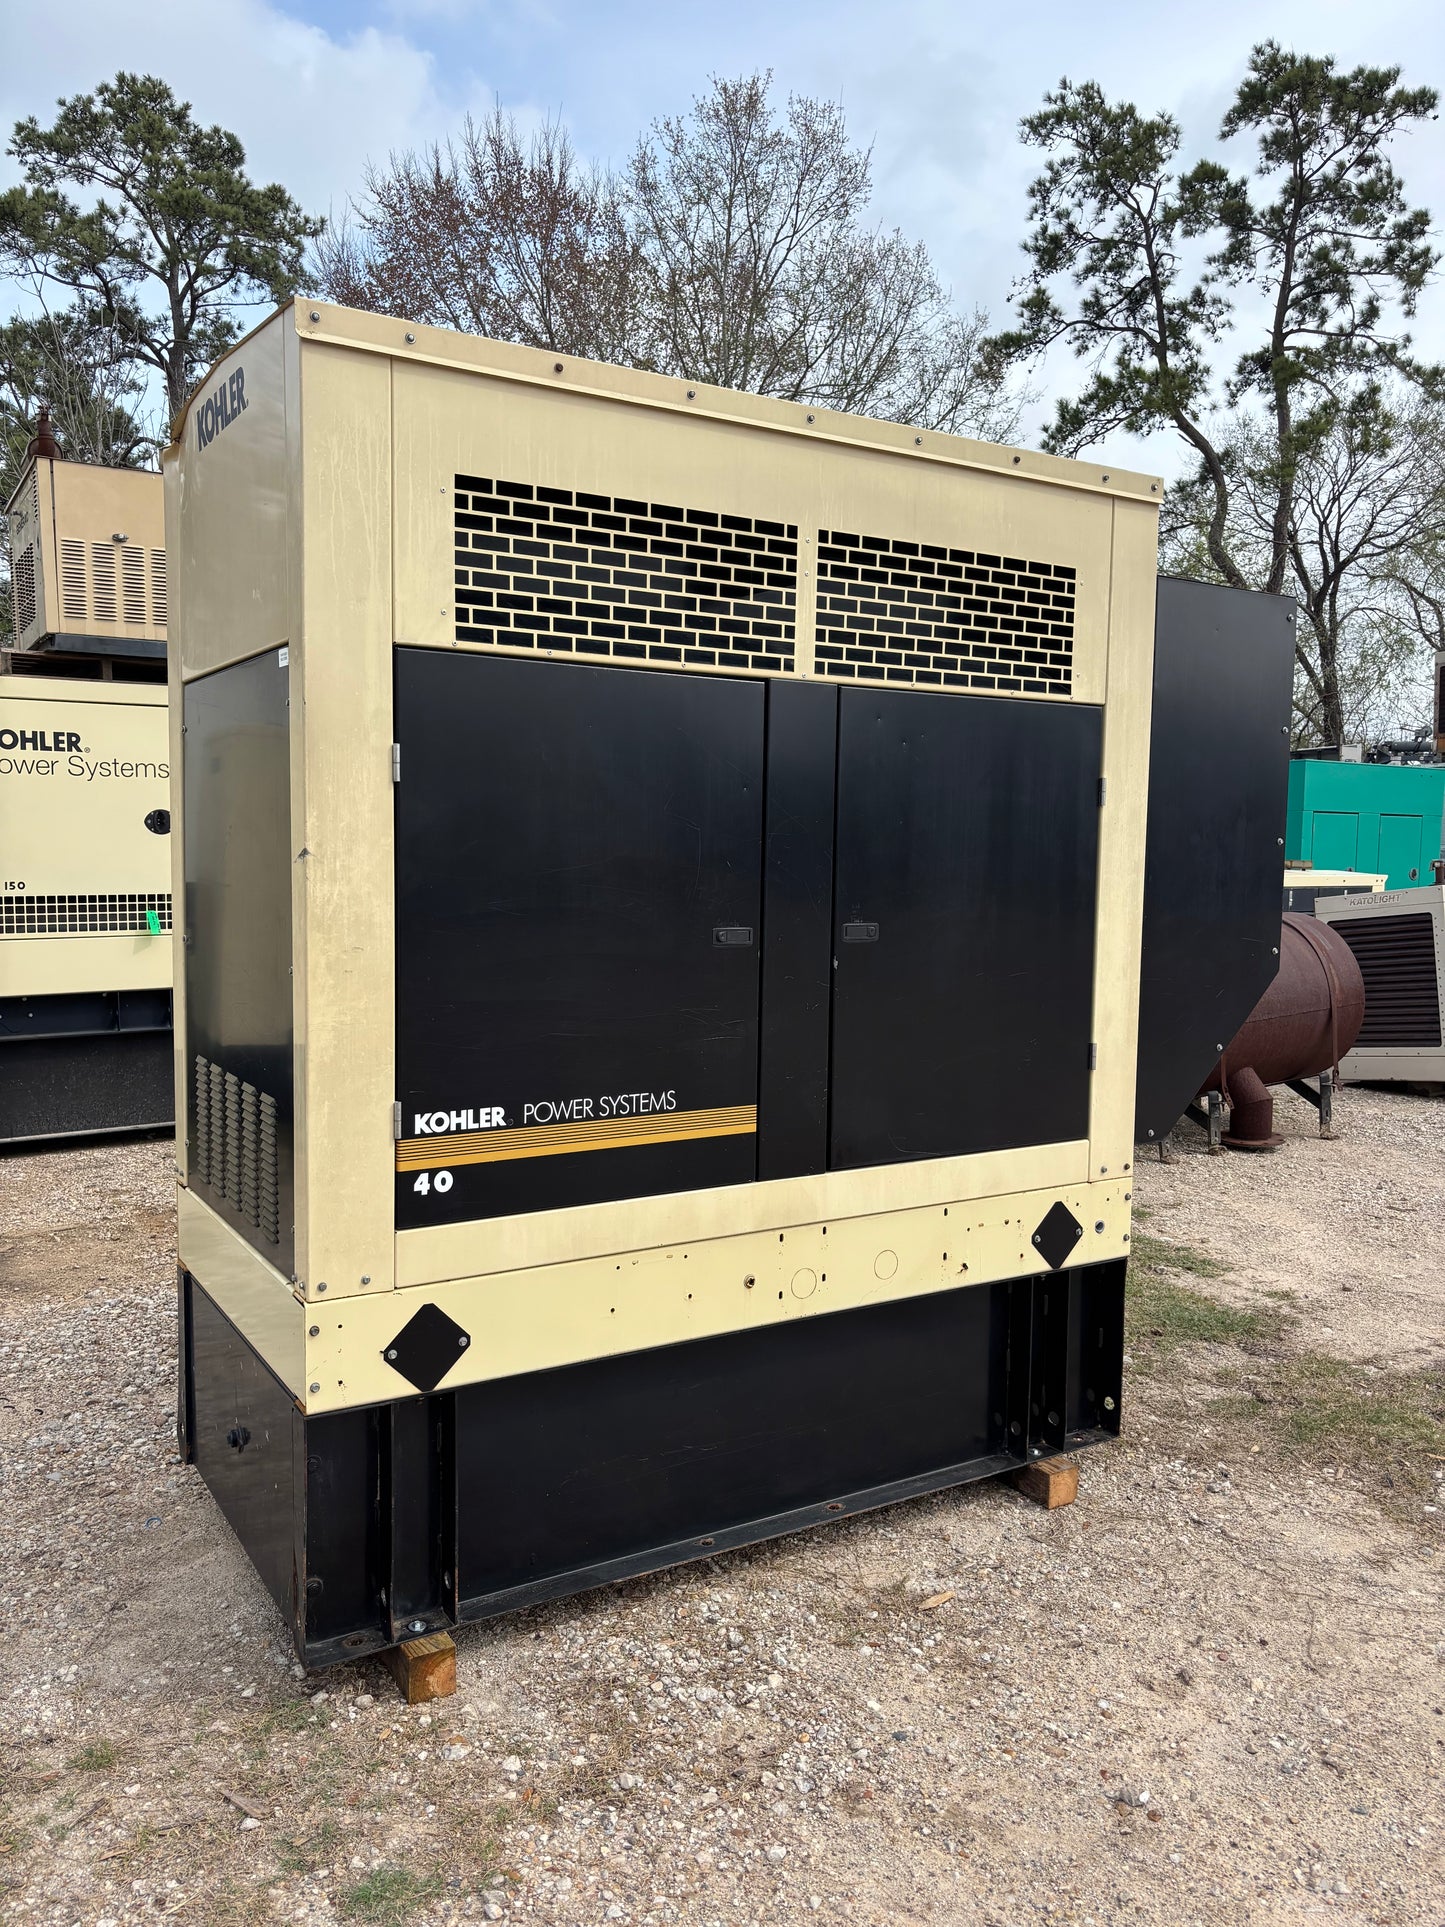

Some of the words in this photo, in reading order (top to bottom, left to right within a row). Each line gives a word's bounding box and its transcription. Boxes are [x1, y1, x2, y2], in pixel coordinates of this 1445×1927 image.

[196, 366, 247, 453] KOHLER
[68, 755, 170, 781] Systems
[4, 881, 26, 891] 150
[1350, 893, 1402, 906] KATOLIGHT
[414, 1106, 507, 1135] KOHLER
[523, 1098, 594, 1124] POWER
[599, 1090, 677, 1117] SYSTEMS
[413, 1170, 454, 1196] 40
